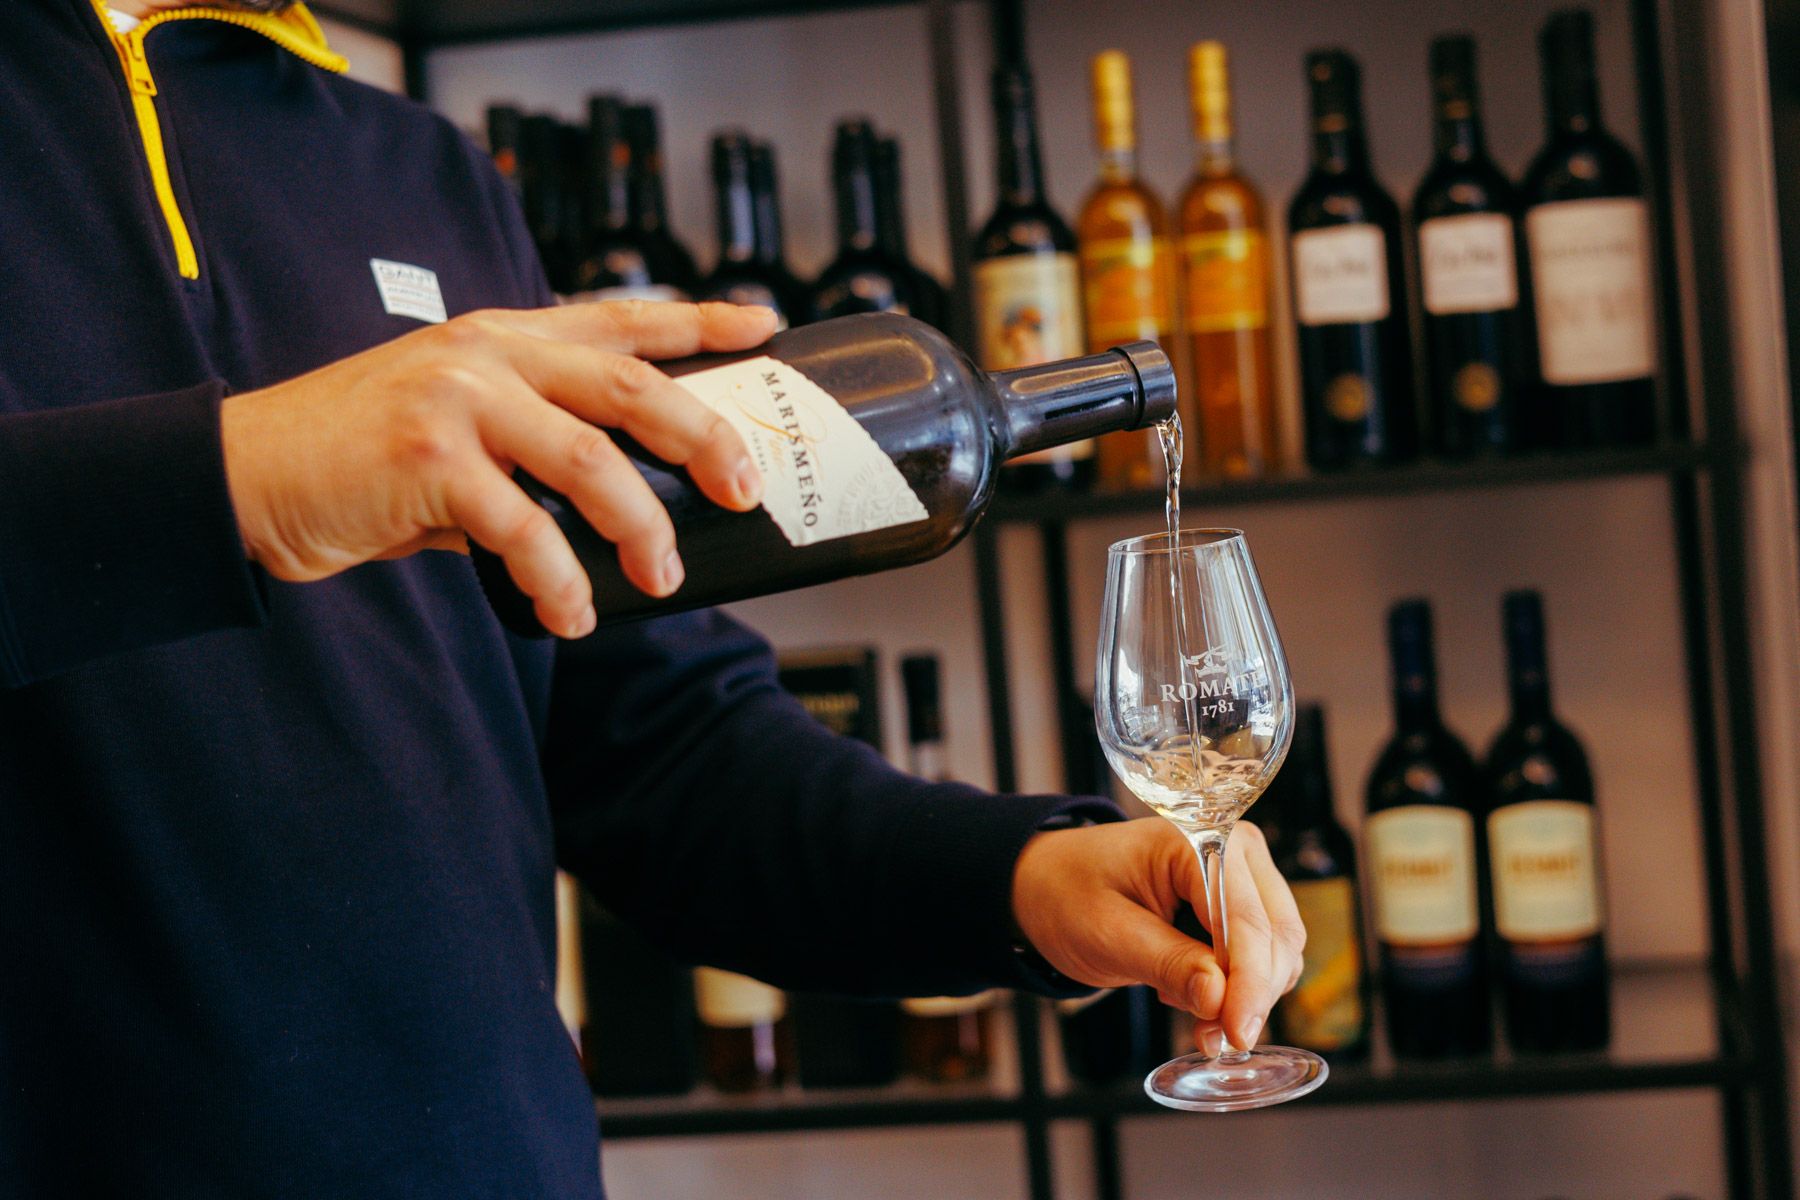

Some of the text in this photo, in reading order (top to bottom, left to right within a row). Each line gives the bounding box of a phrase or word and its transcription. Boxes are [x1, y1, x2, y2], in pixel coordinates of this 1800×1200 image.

[762, 371, 822, 528] MARISMEÑO
[1160, 672, 1264, 703] ROMATE
[1202, 699, 1235, 718] 1781
